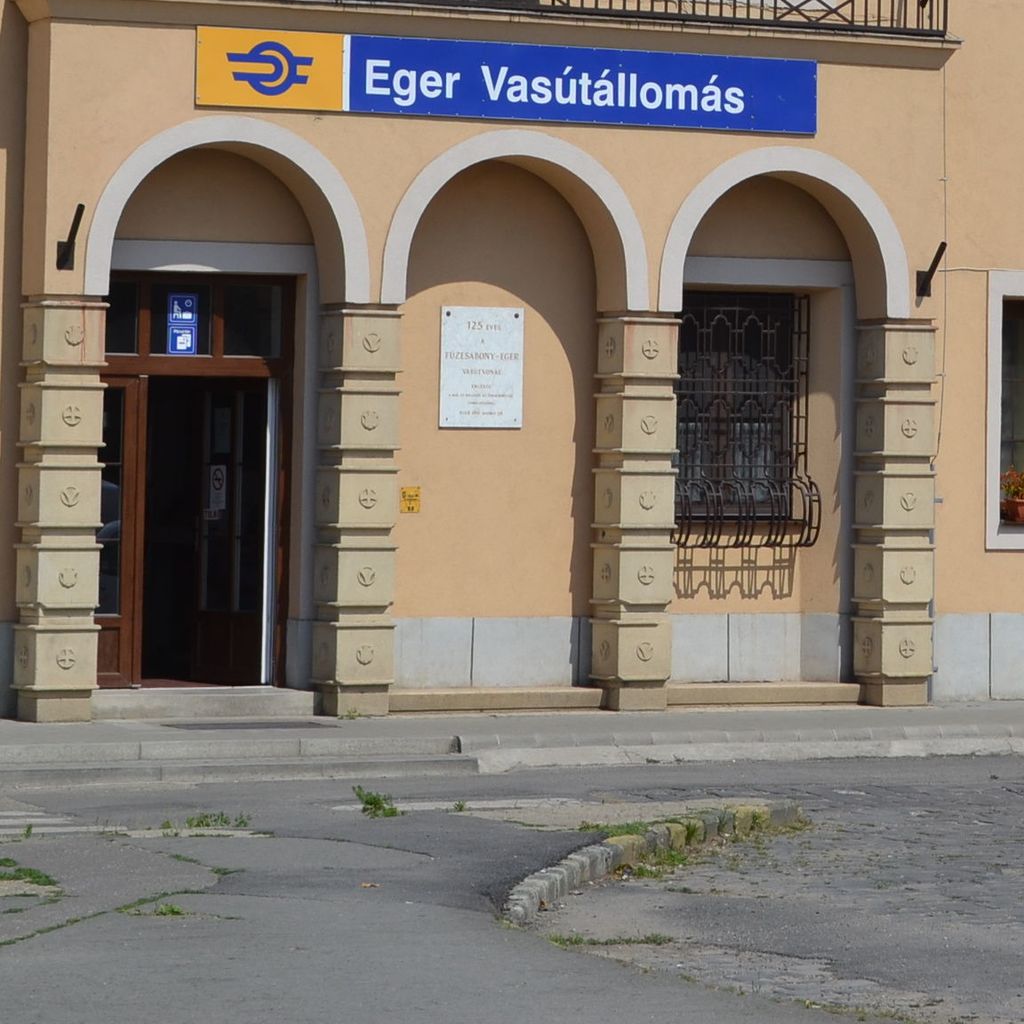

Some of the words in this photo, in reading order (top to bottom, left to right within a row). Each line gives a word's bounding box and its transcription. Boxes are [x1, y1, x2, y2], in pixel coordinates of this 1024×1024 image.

[364, 58, 460, 107] Eger
[480, 63, 745, 115] Vasútállomás
[467, 321, 482, 330] 125
